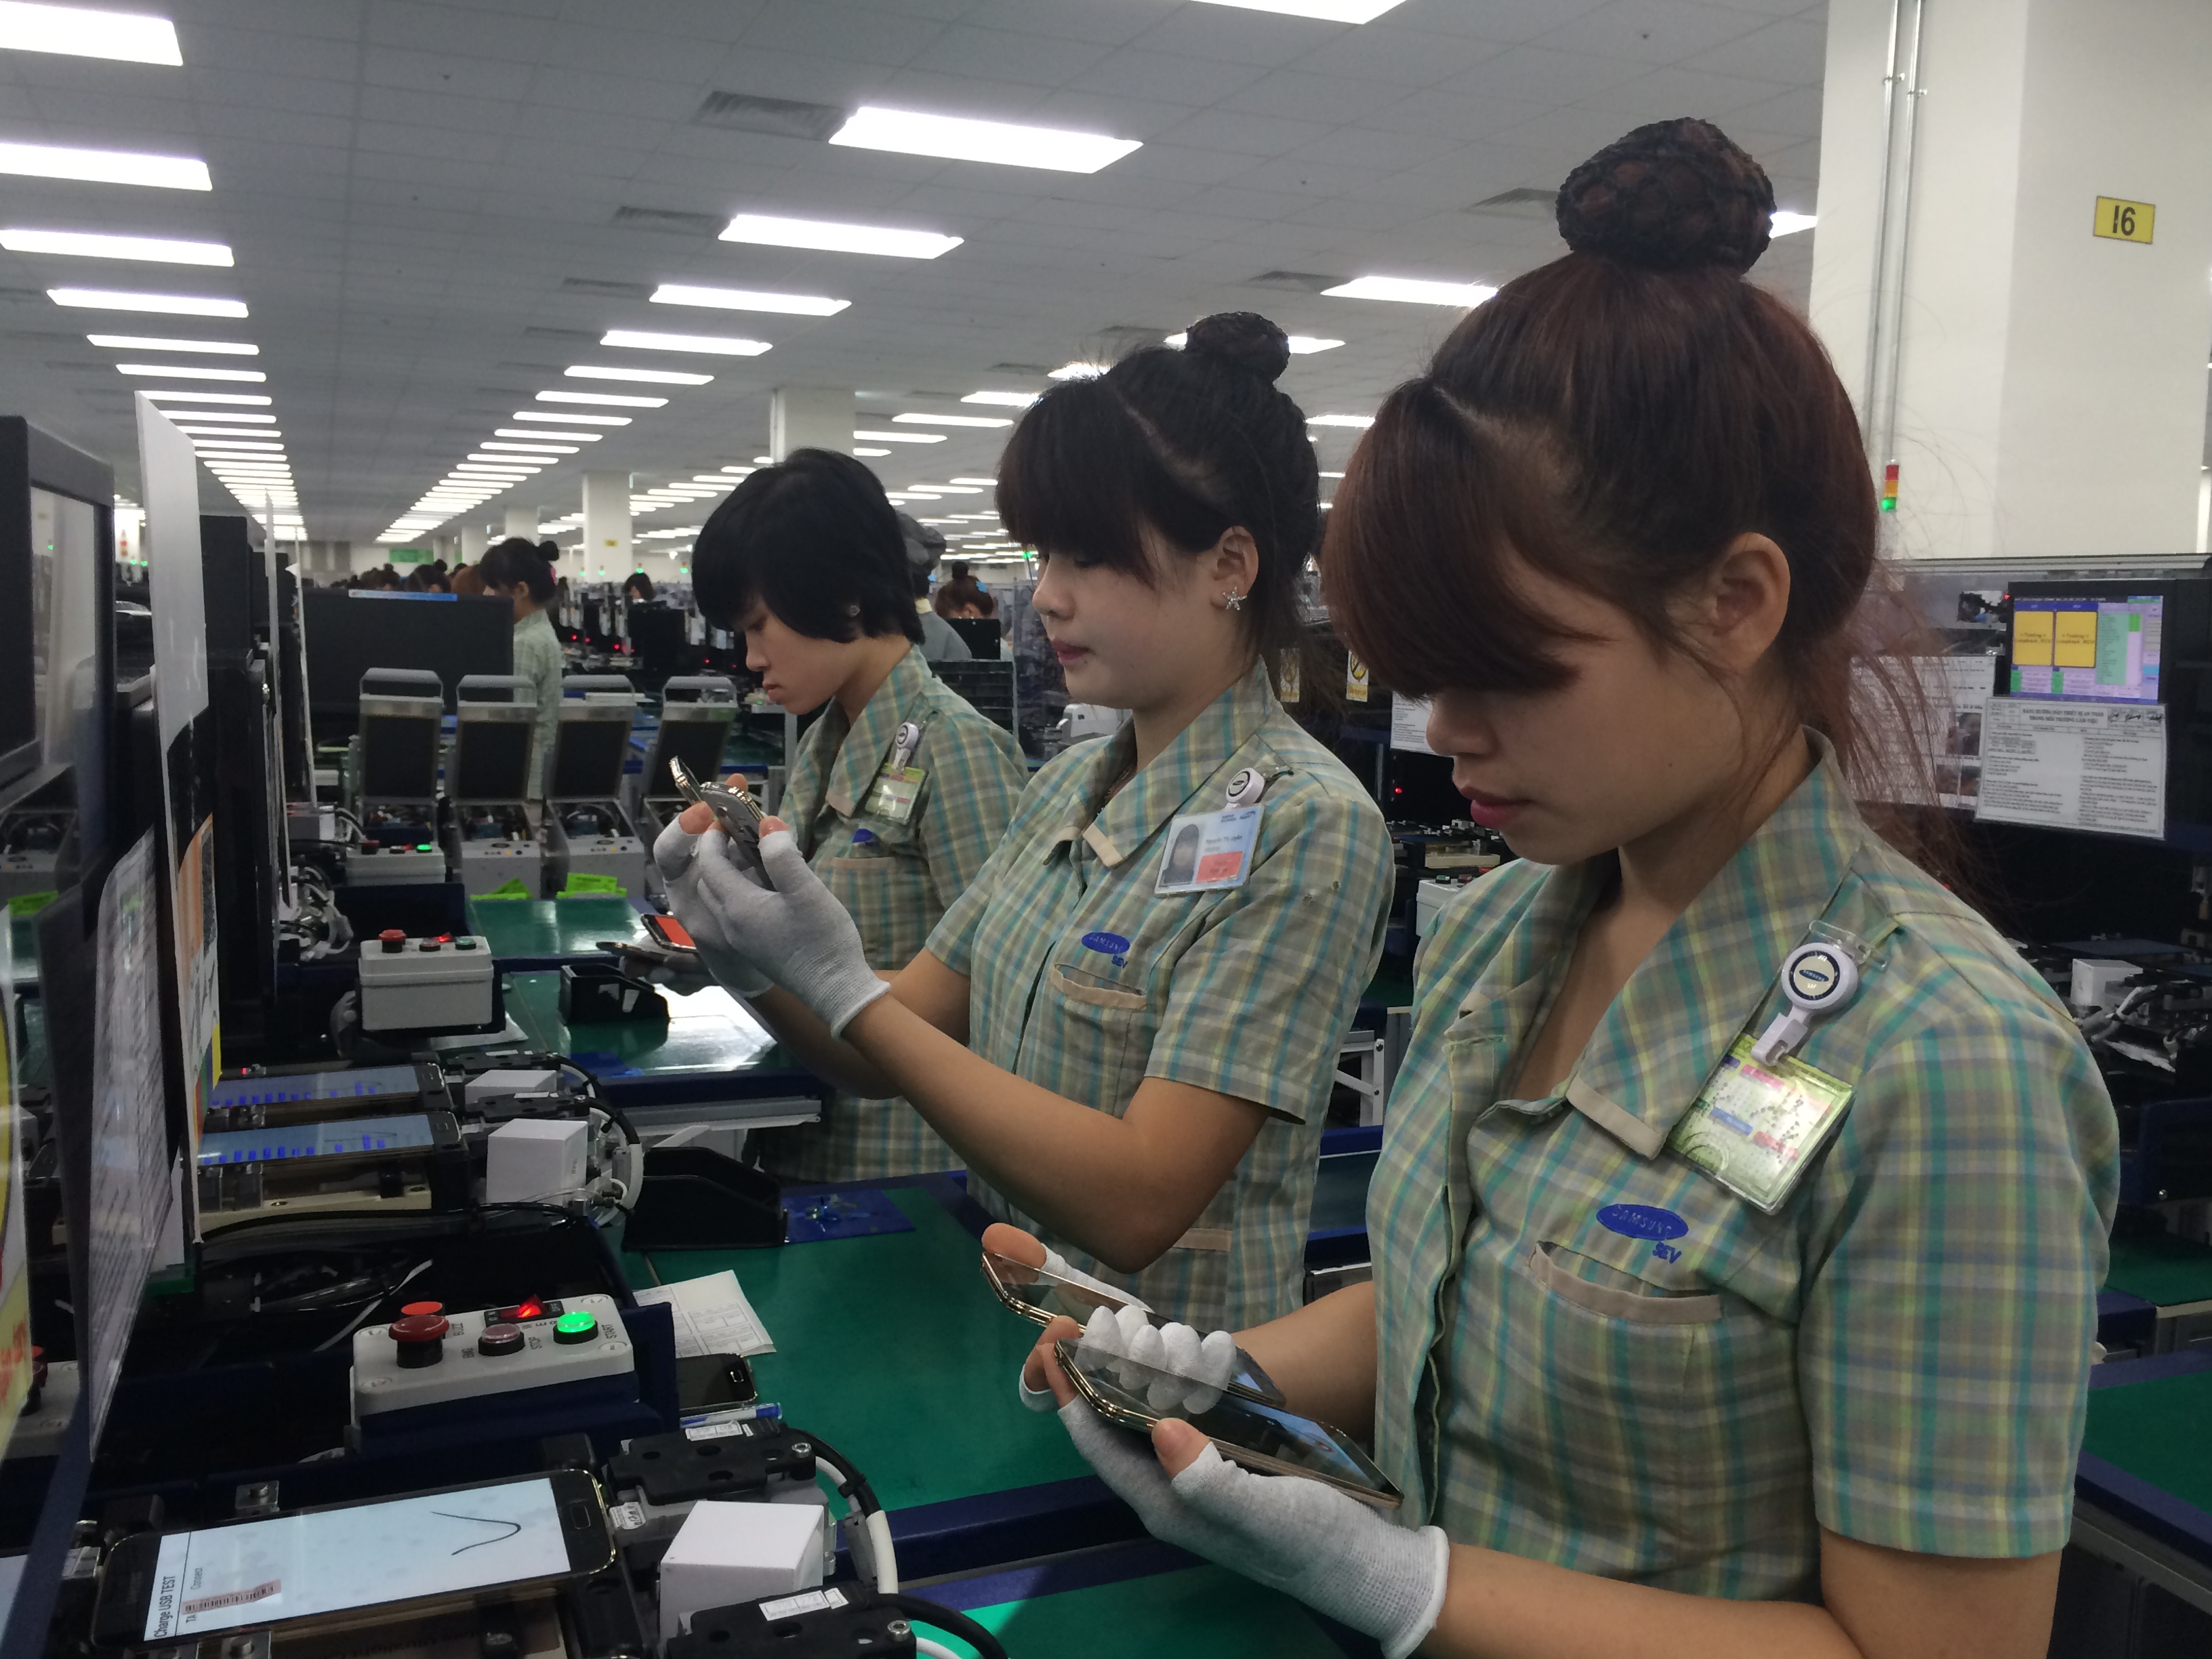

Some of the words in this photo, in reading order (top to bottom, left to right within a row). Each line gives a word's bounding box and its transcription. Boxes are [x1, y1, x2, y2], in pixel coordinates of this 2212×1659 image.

[551, 1302, 561, 1313] OFF
[488, 1311, 498, 1322] ON
[601, 1324, 617, 1340] START
[528, 1336, 543, 1350] STOP
[161, 1576, 176, 1595] TEST
[159, 1595, 172, 1612] USB
[153, 1611, 173, 1637] Charge
